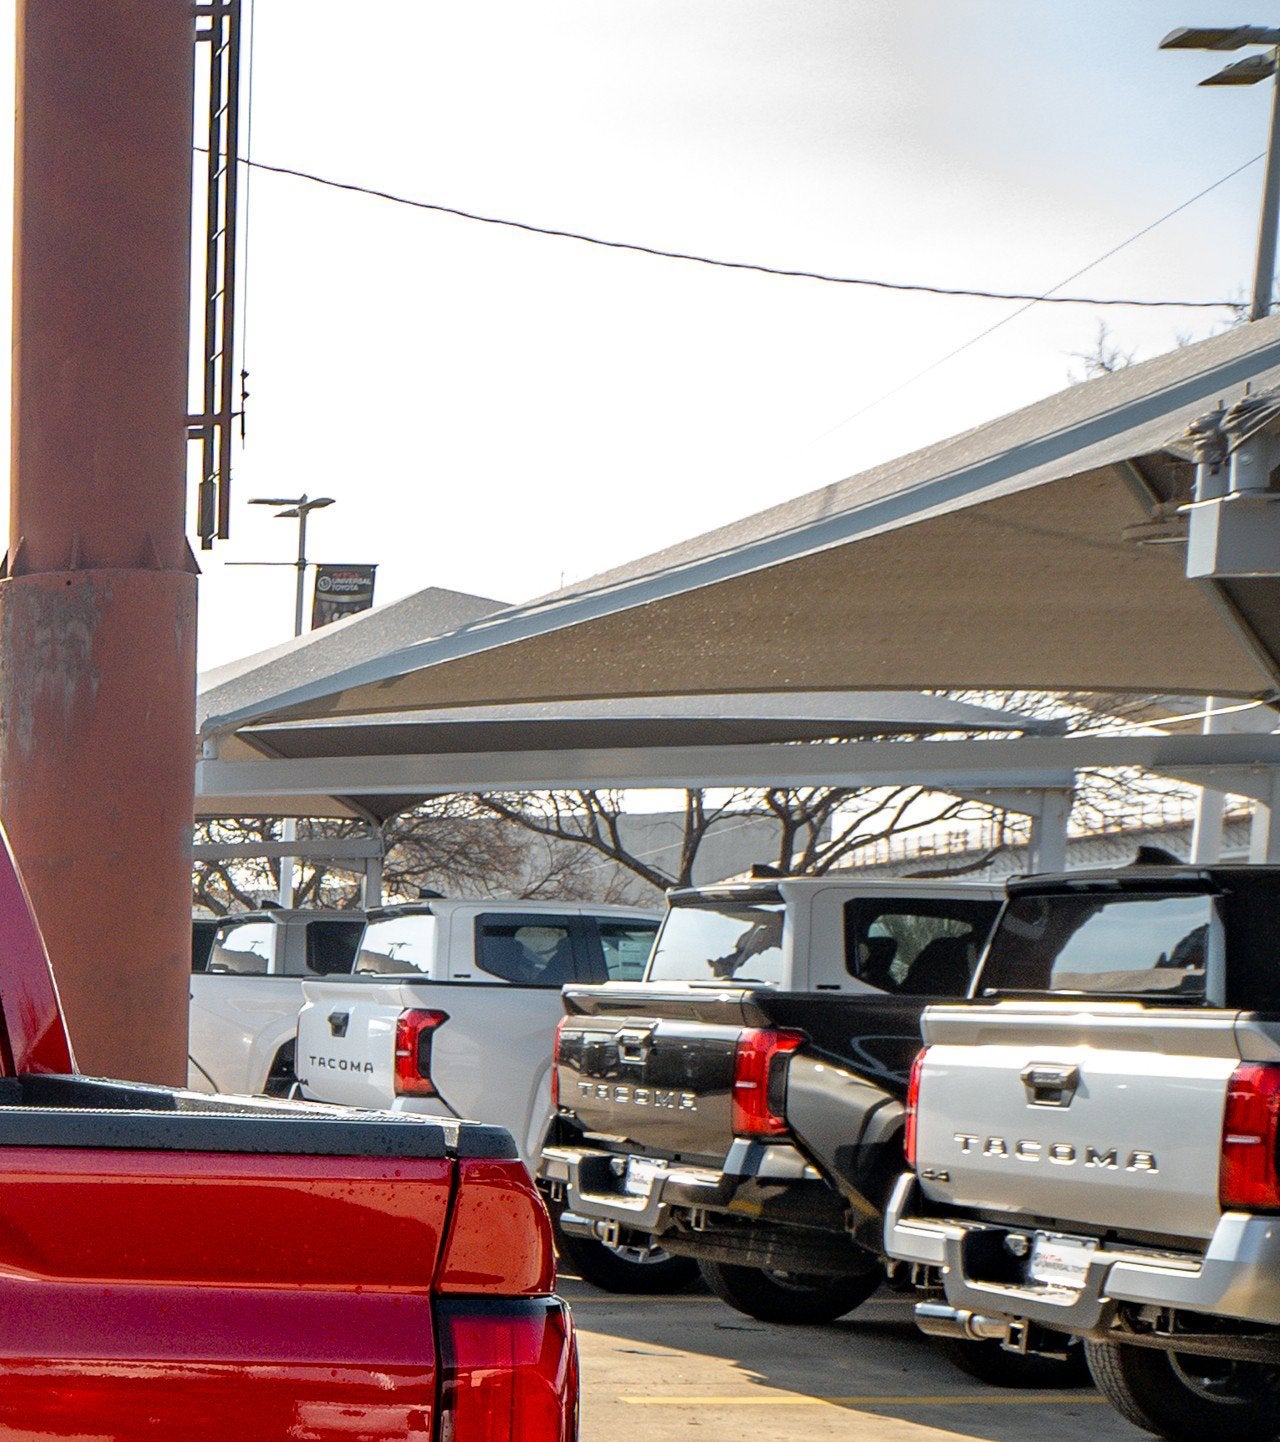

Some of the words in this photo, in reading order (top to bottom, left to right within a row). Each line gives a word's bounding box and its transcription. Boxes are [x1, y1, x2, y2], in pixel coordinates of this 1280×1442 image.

[309, 1055, 374, 1073] TACOMA
[577, 1081, 697, 1111] TACOMA
[954, 1133, 1159, 1174] TACOMA
